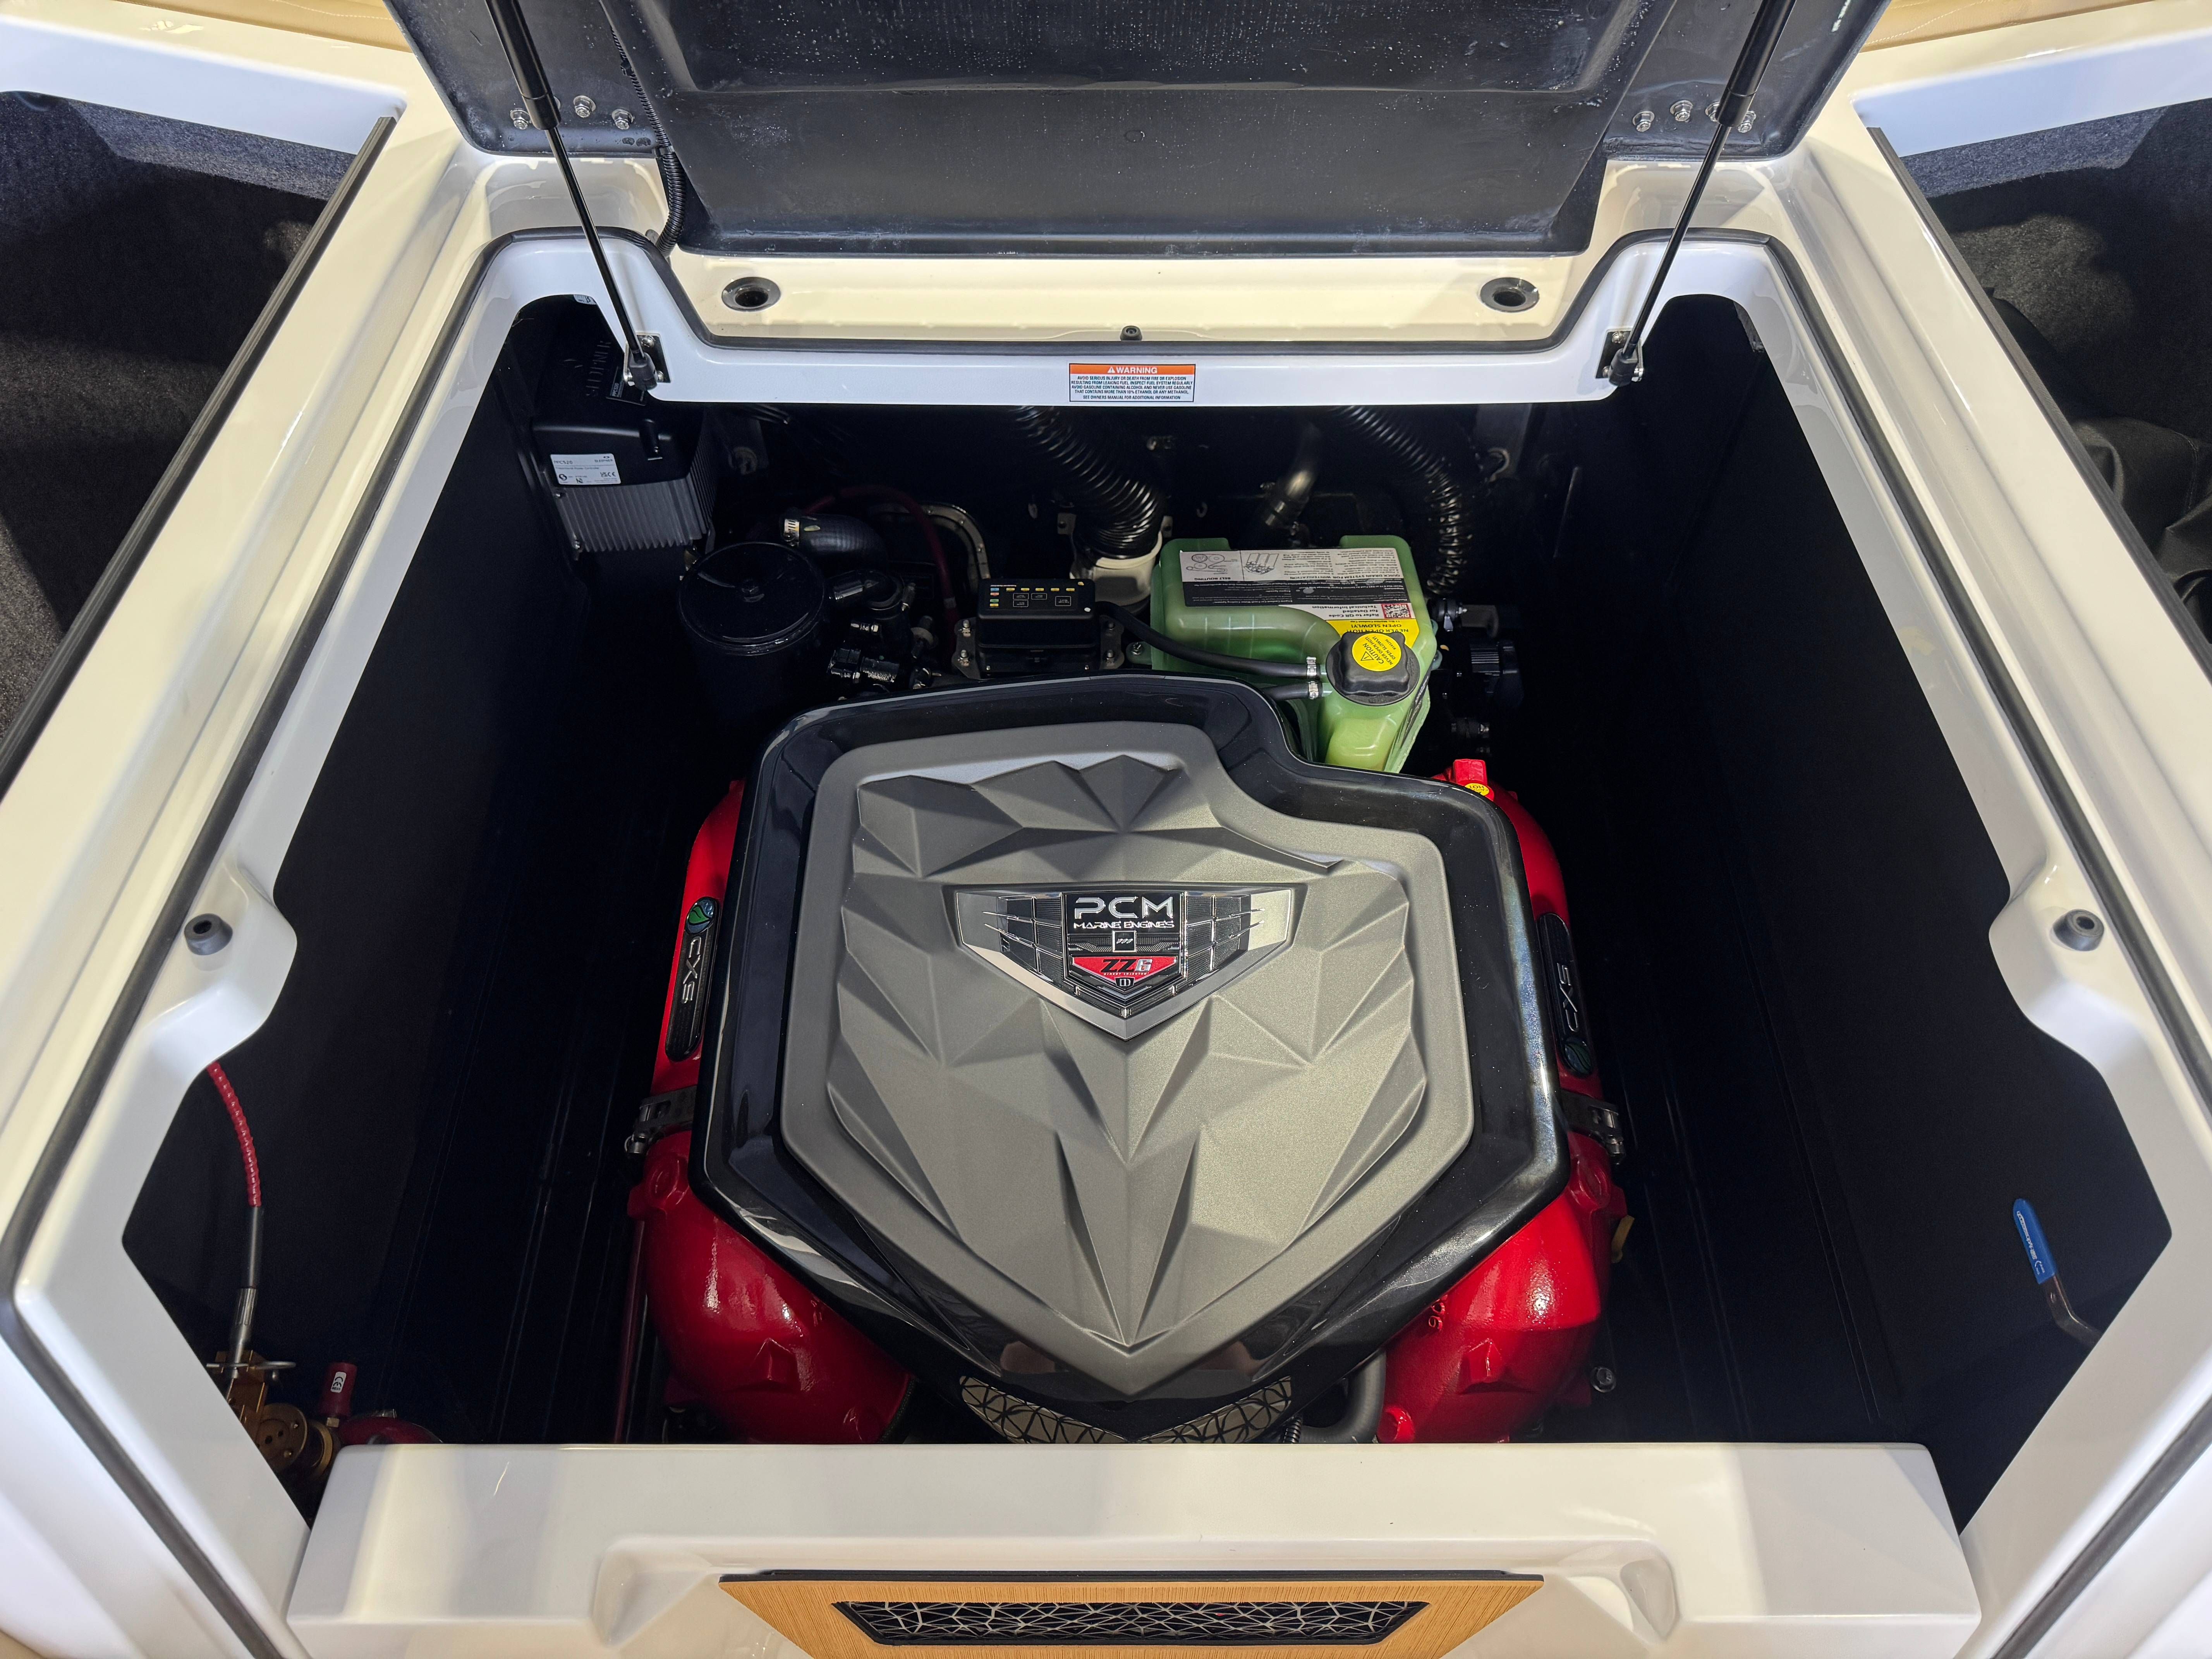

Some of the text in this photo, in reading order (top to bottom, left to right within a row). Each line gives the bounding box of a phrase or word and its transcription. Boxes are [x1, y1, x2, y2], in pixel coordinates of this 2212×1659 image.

[1362, 643, 1384, 664] CAUTION
[1365, 636, 1393, 665] NEVER OPEN HOT!
[1372, 636, 1396, 660] OPEN SLOWLY!
[1075, 896, 1173, 919] PCM
[1101, 958, 1153, 972] ZZ6
